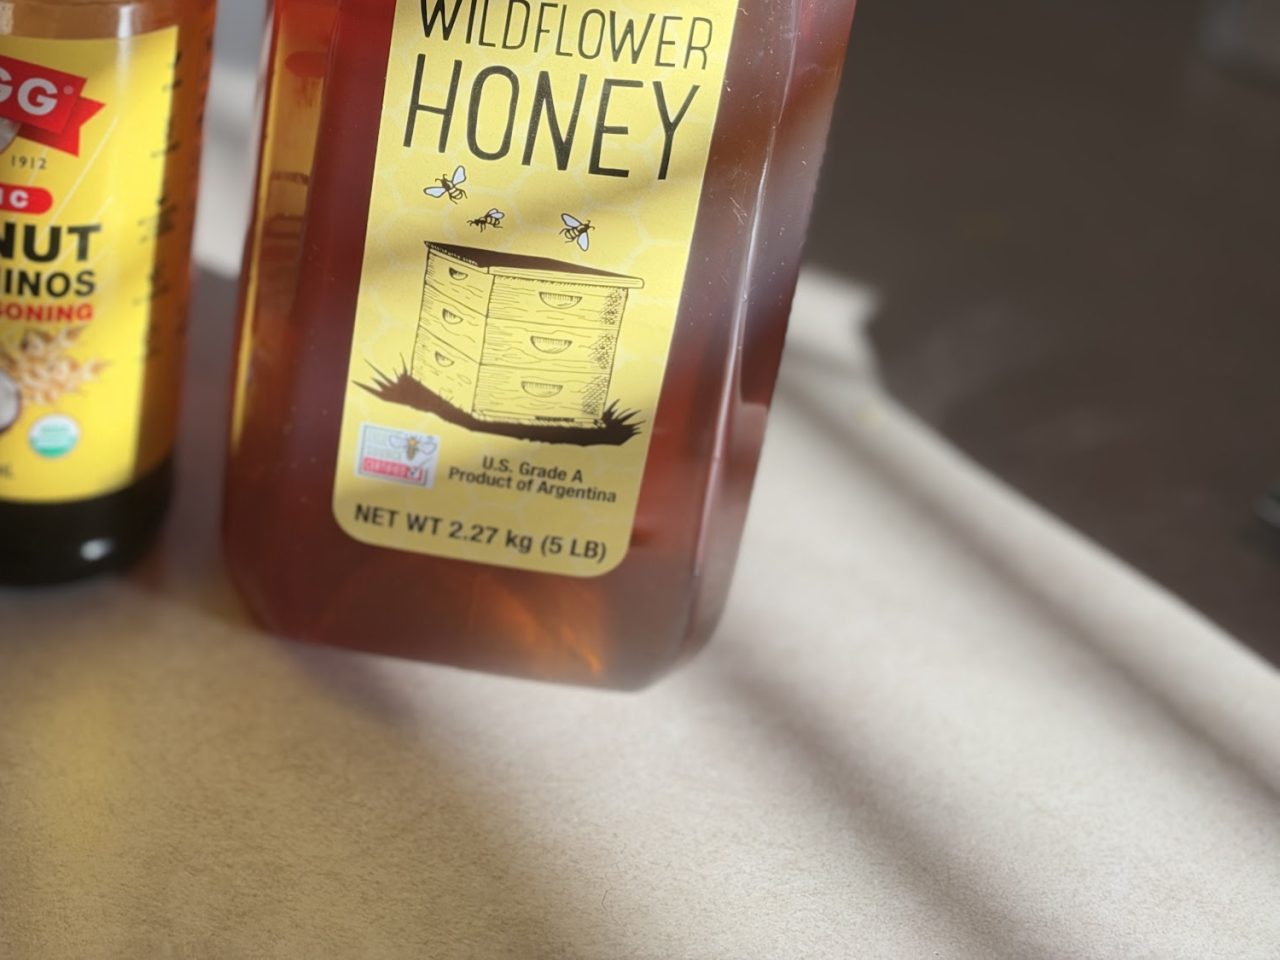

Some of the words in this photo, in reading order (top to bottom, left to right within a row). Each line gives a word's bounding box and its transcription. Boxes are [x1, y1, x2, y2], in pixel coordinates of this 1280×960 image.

[403, 53, 700, 180] HONEY
[11, 155, 48, 170] 1912
[448, 466, 512, 490] Product
[516, 477, 533, 492] of
[535, 480, 617, 503] Argentina
[482, 456, 513, 474] U.S.
[519, 461, 567, 483] Grade
[571, 469, 583, 483] A
[354, 503, 400, 529] NET
[406, 512, 443, 536] WT
[448, 520, 499, 545] 2.27
[505, 529, 533, 554] kg
[540, 534, 563, 558] (5
[569, 539, 607, 565] LB)
